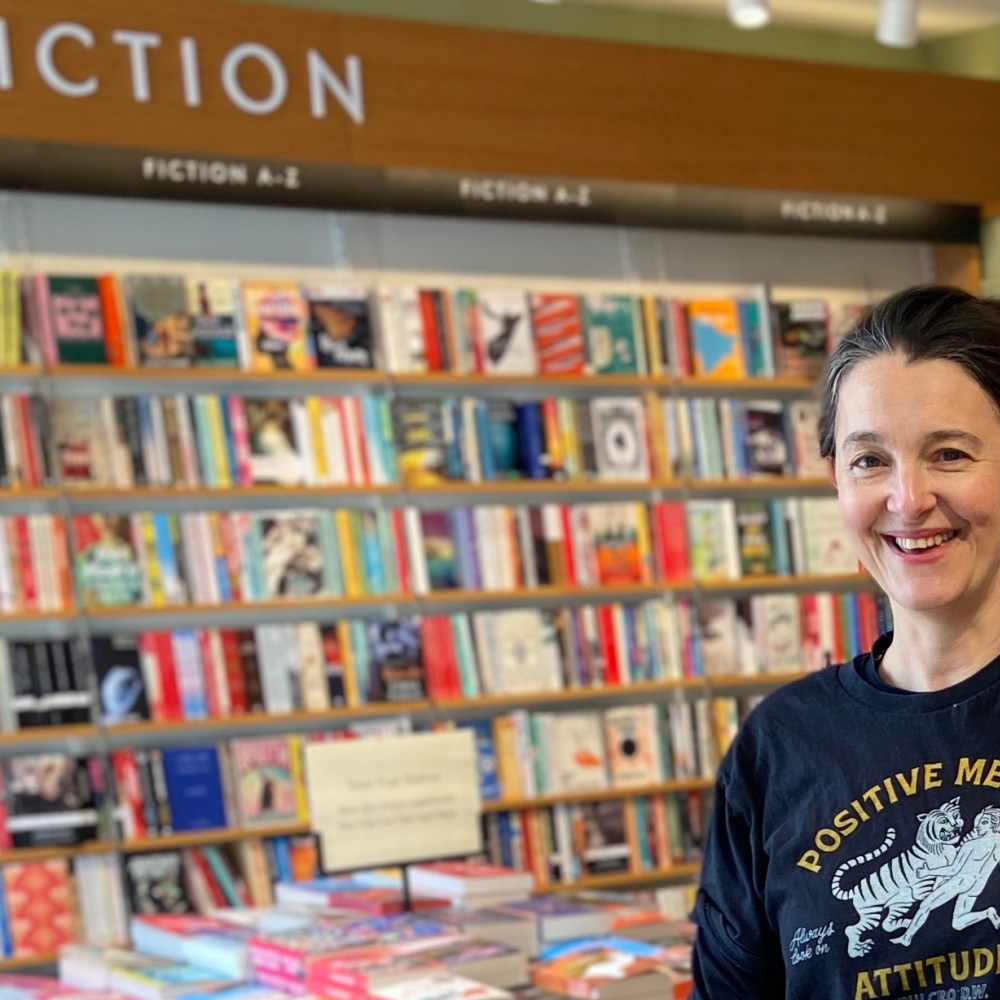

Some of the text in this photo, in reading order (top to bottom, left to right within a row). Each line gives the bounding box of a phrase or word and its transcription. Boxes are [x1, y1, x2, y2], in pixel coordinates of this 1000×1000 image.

[142, 156, 301, 190] FICTION A-Z
[459, 178, 592, 207] FICTION A-Z
[796, 762, 943, 874] POSITIVE
[789, 920, 836, 951] Always
[789, 942, 830, 966] look on
